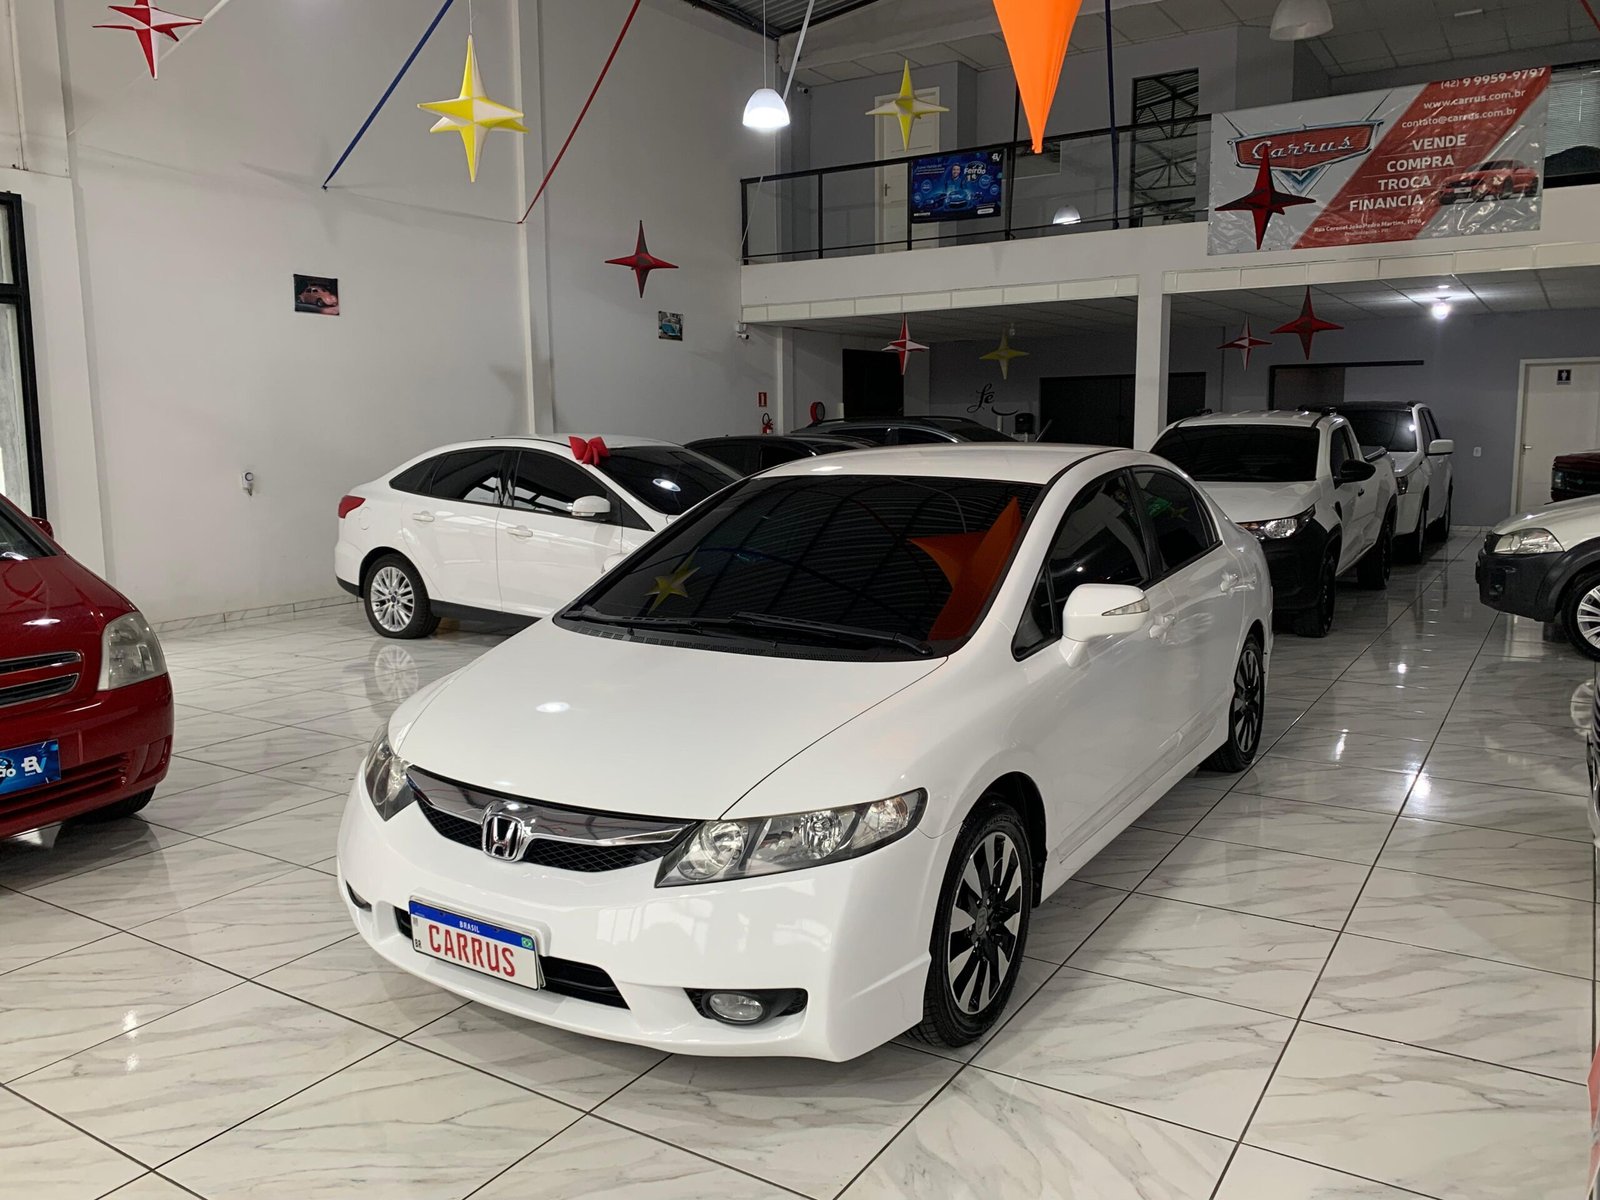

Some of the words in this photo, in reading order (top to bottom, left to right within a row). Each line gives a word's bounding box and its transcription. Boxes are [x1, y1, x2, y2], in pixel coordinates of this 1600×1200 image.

[1441, 79, 1460, 89] (42)
[1463, 77, 1471, 87] 9
[1474, 67, 1546, 86] 9959-9797
[1423, 89, 1526, 109] www.carrus.com.br
[1401, 107, 1518, 128] contato@carrus.com.br
[1252, 136, 1354, 159] Carrus
[1412, 134, 1467, 151] VENDE
[1386, 154, 1455, 172] COMPRA
[1378, 175, 1432, 191] TROCA
[1349, 194, 1424, 212] FINANCIA
[459, 920, 480, 933] BRASIL
[414, 938, 422, 949] BR
[428, 923, 516, 978] CARRUS
